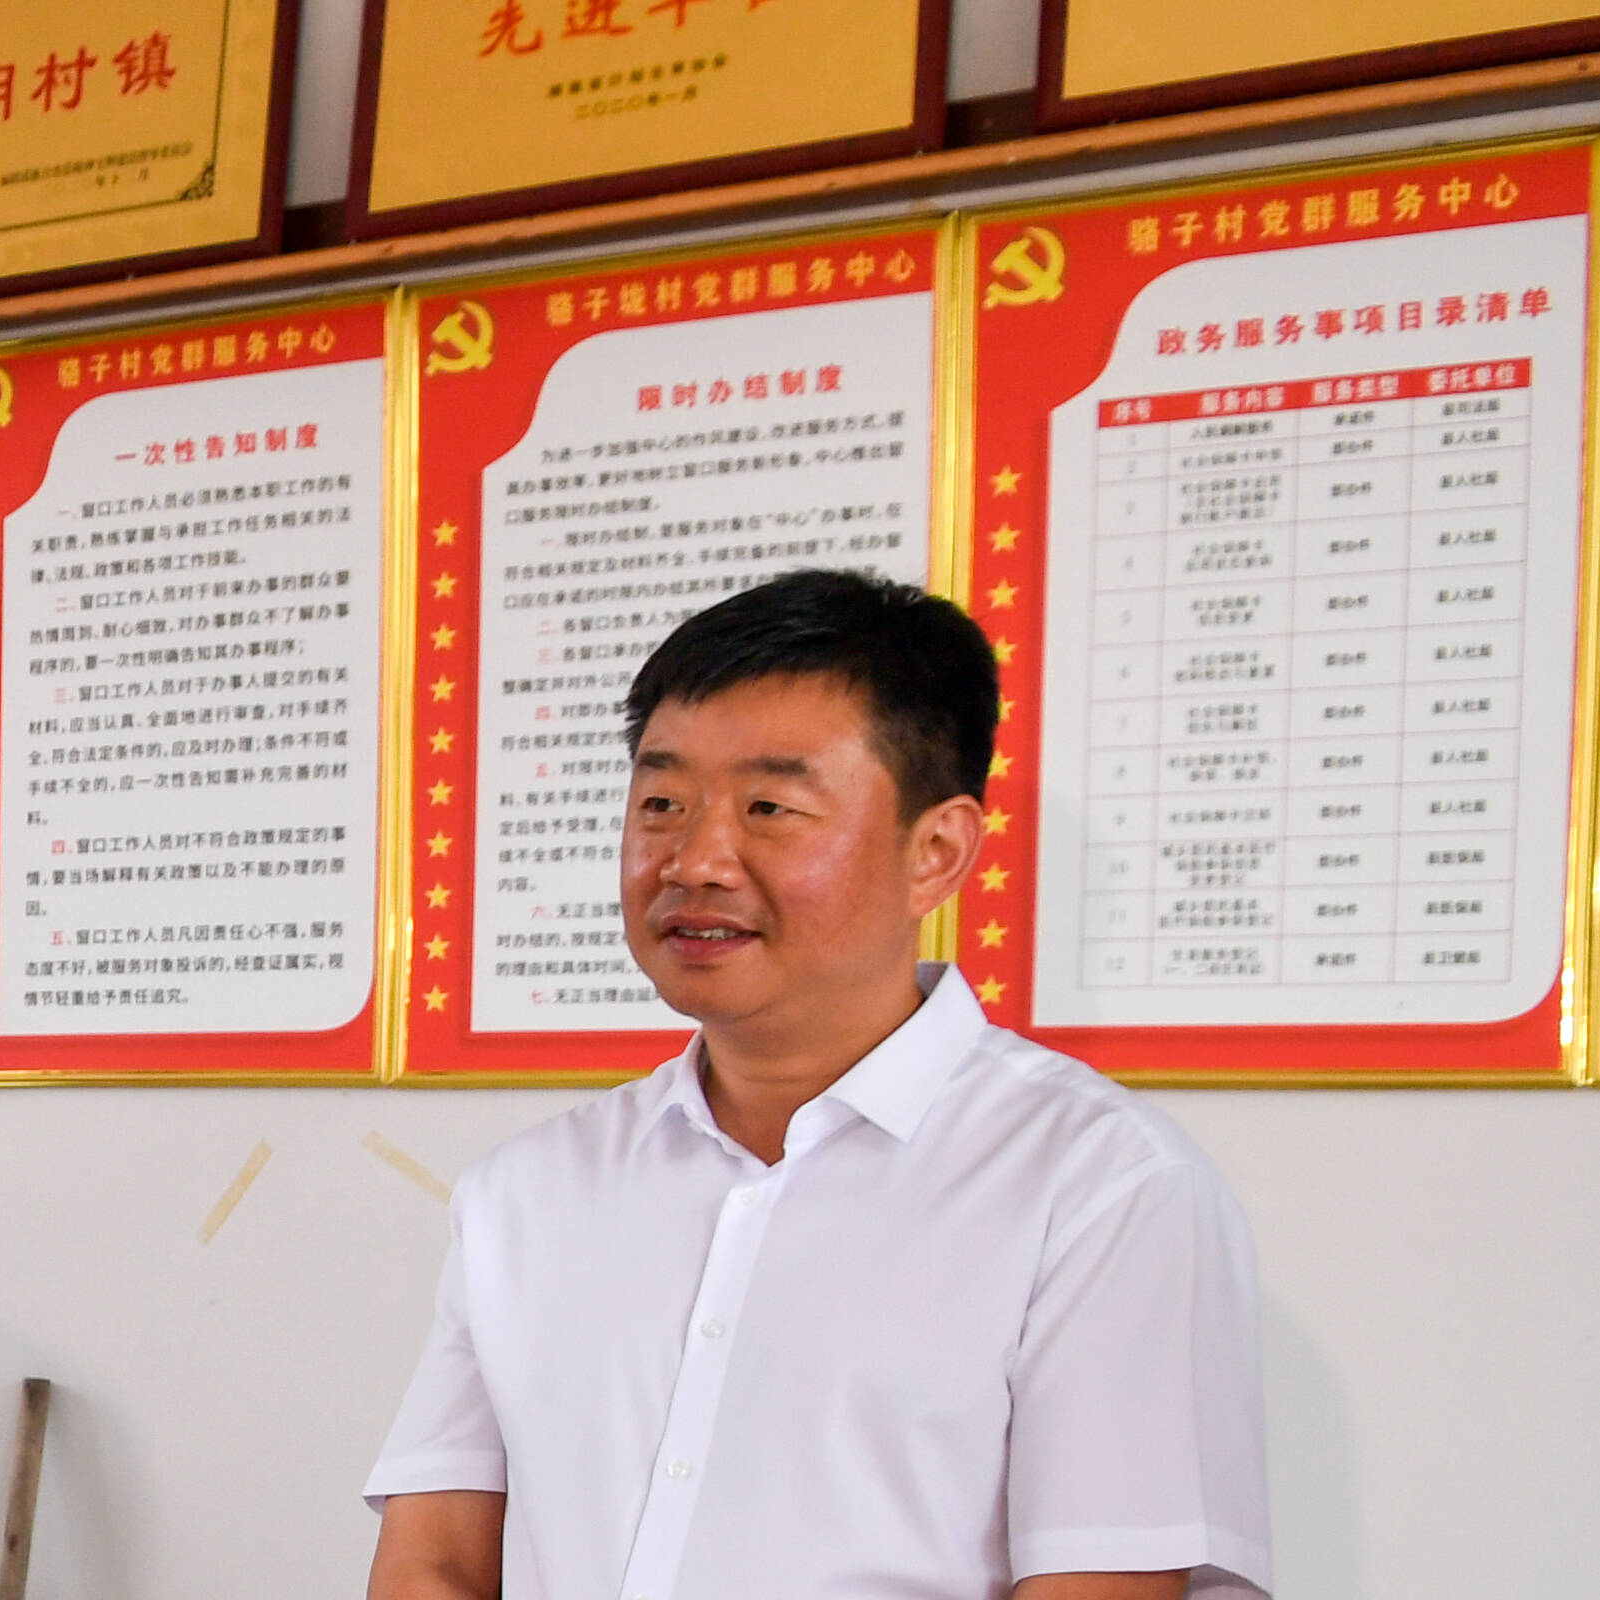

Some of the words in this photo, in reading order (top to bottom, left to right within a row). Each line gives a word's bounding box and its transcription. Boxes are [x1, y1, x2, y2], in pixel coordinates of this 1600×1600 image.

[1157, 287, 1552, 355] 政务服务事项目录清单
[638, 365, 842, 411] 限时办结制度
[1311, 377, 1399, 403] 服务类型
[1428, 366, 1516, 395] 委托单位
[1201, 387, 1285, 414] 服务内容
[115, 423, 318, 465] 一次性告知制度
